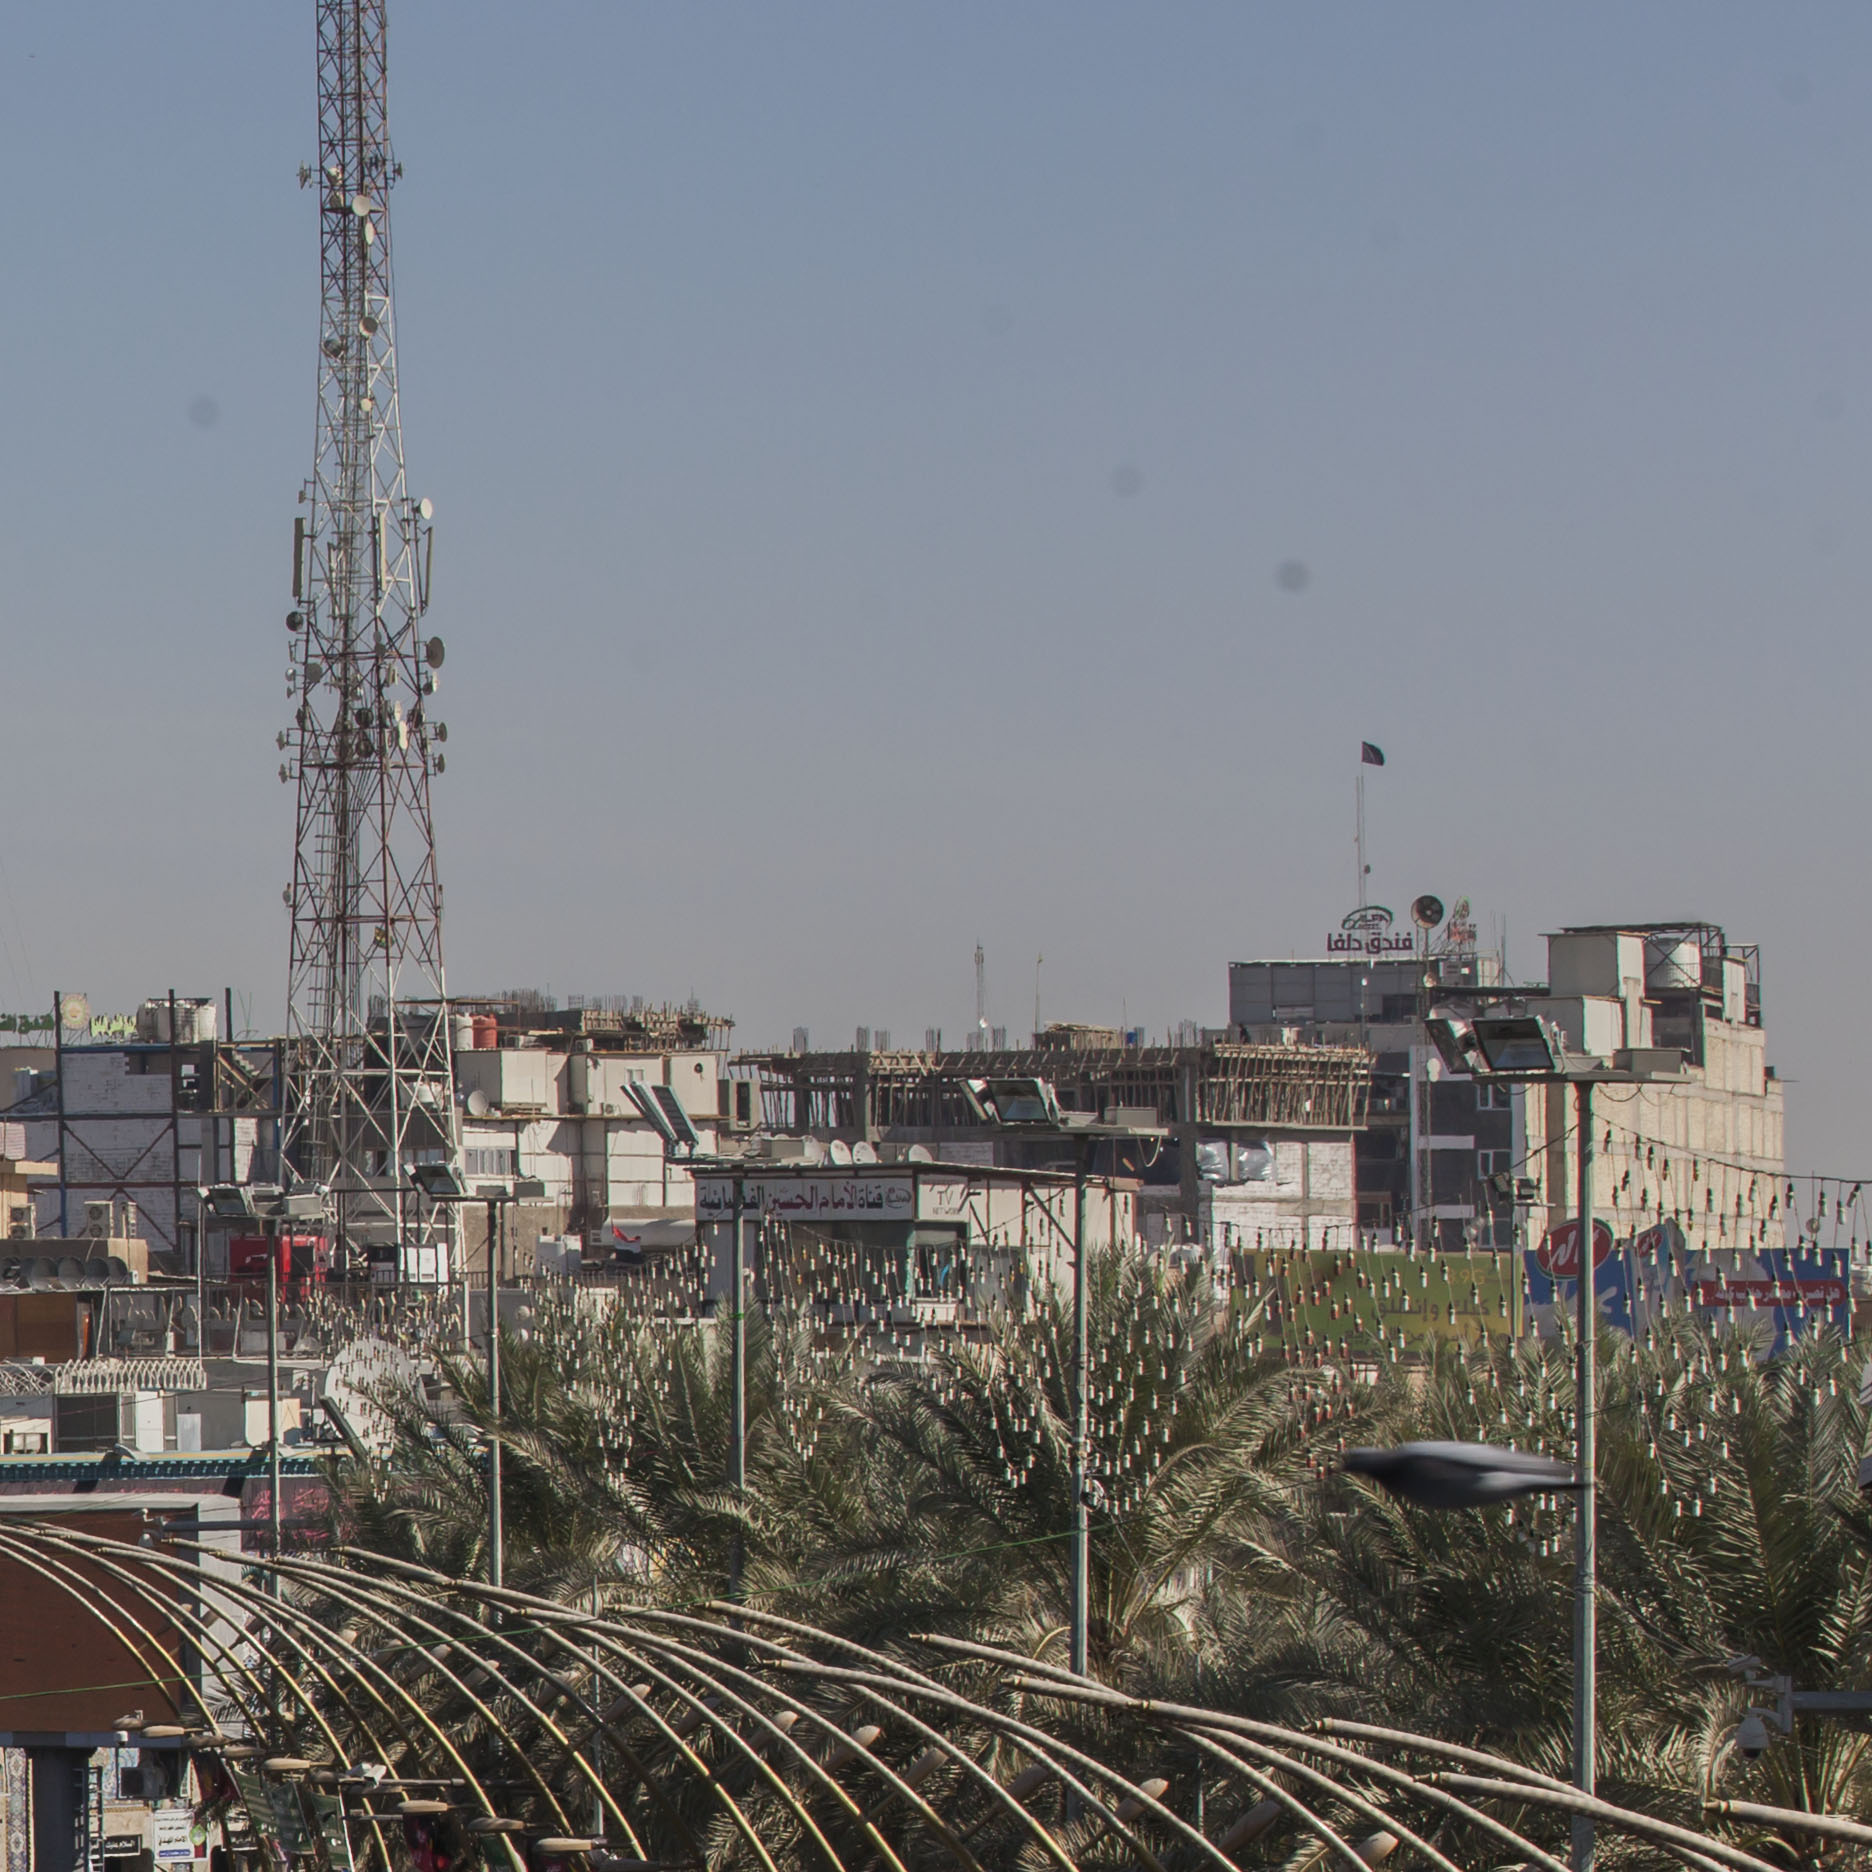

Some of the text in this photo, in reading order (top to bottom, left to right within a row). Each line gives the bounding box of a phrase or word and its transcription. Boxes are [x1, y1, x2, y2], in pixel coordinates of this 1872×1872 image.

[1365, 932, 1413, 954] فندق
[858, 1183, 883, 1209] قناة
[937, 1191, 953, 1207] TV
